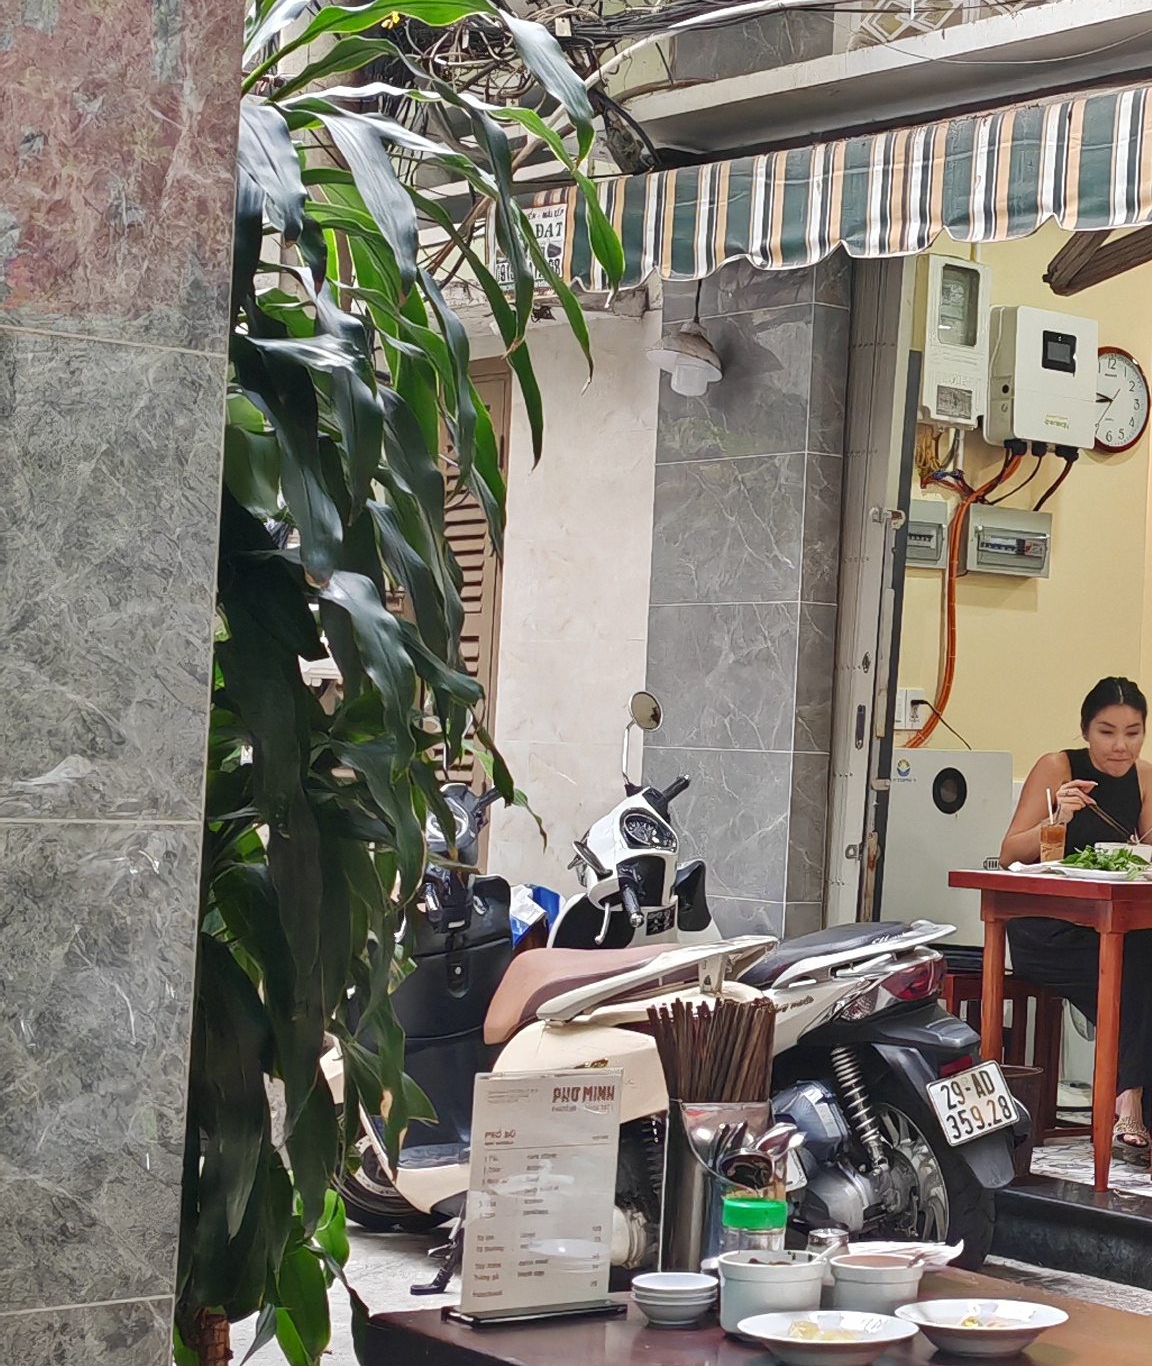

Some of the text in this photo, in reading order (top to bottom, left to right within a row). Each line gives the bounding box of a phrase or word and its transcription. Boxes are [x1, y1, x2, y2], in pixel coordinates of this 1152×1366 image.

[1107, 358, 1117, 370] 12
[1128, 381, 1136, 392] 2
[1133, 398, 1140, 410] 3
[1129, 416, 1135, 427] 4
[1106, 430, 1113, 442] 6
[1118, 428, 1125, 440] 5
[940, 1070, 995, 1111] 29-AD
[946, 1095, 1012, 1139] 359.28
